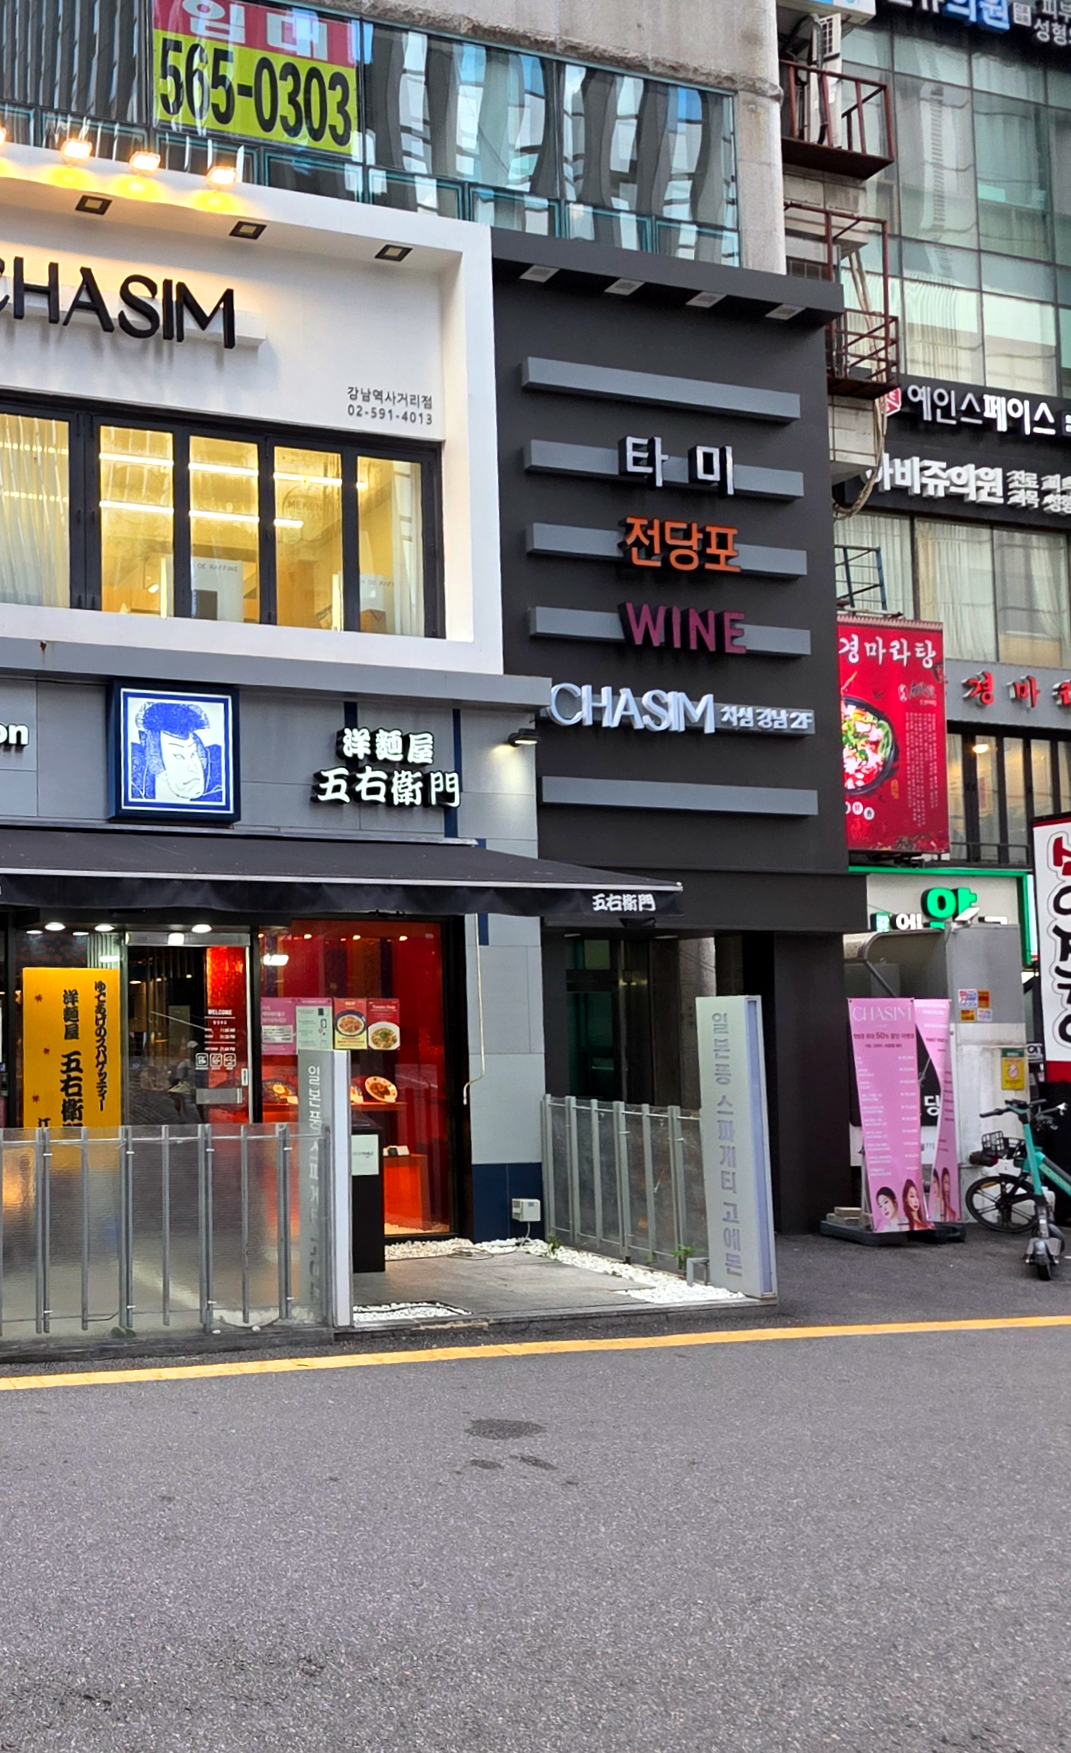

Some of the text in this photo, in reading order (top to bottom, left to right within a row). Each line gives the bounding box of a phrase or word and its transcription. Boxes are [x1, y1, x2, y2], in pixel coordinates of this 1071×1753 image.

[160, 37, 353, 147] 565-0303
[347, 386, 433, 410] 강남역사거리점
[347, 404, 433, 426] 02-591-4013
[626, 516, 742, 572] 전당포
[626, 602, 746, 654] WINE
[550, 683, 716, 734] CHASIM
[756, 707, 788, 729] 강남
[790, 712, 813, 729] 2F
[317, 766, 461, 808] 五右衛門
[592, 893, 656, 912] 五右衛門
[852, 1006, 912, 1022] CHASIM
[59, 1050, 84, 1127] 五右衛
[717, 1095, 737, 1194] 스파게티
